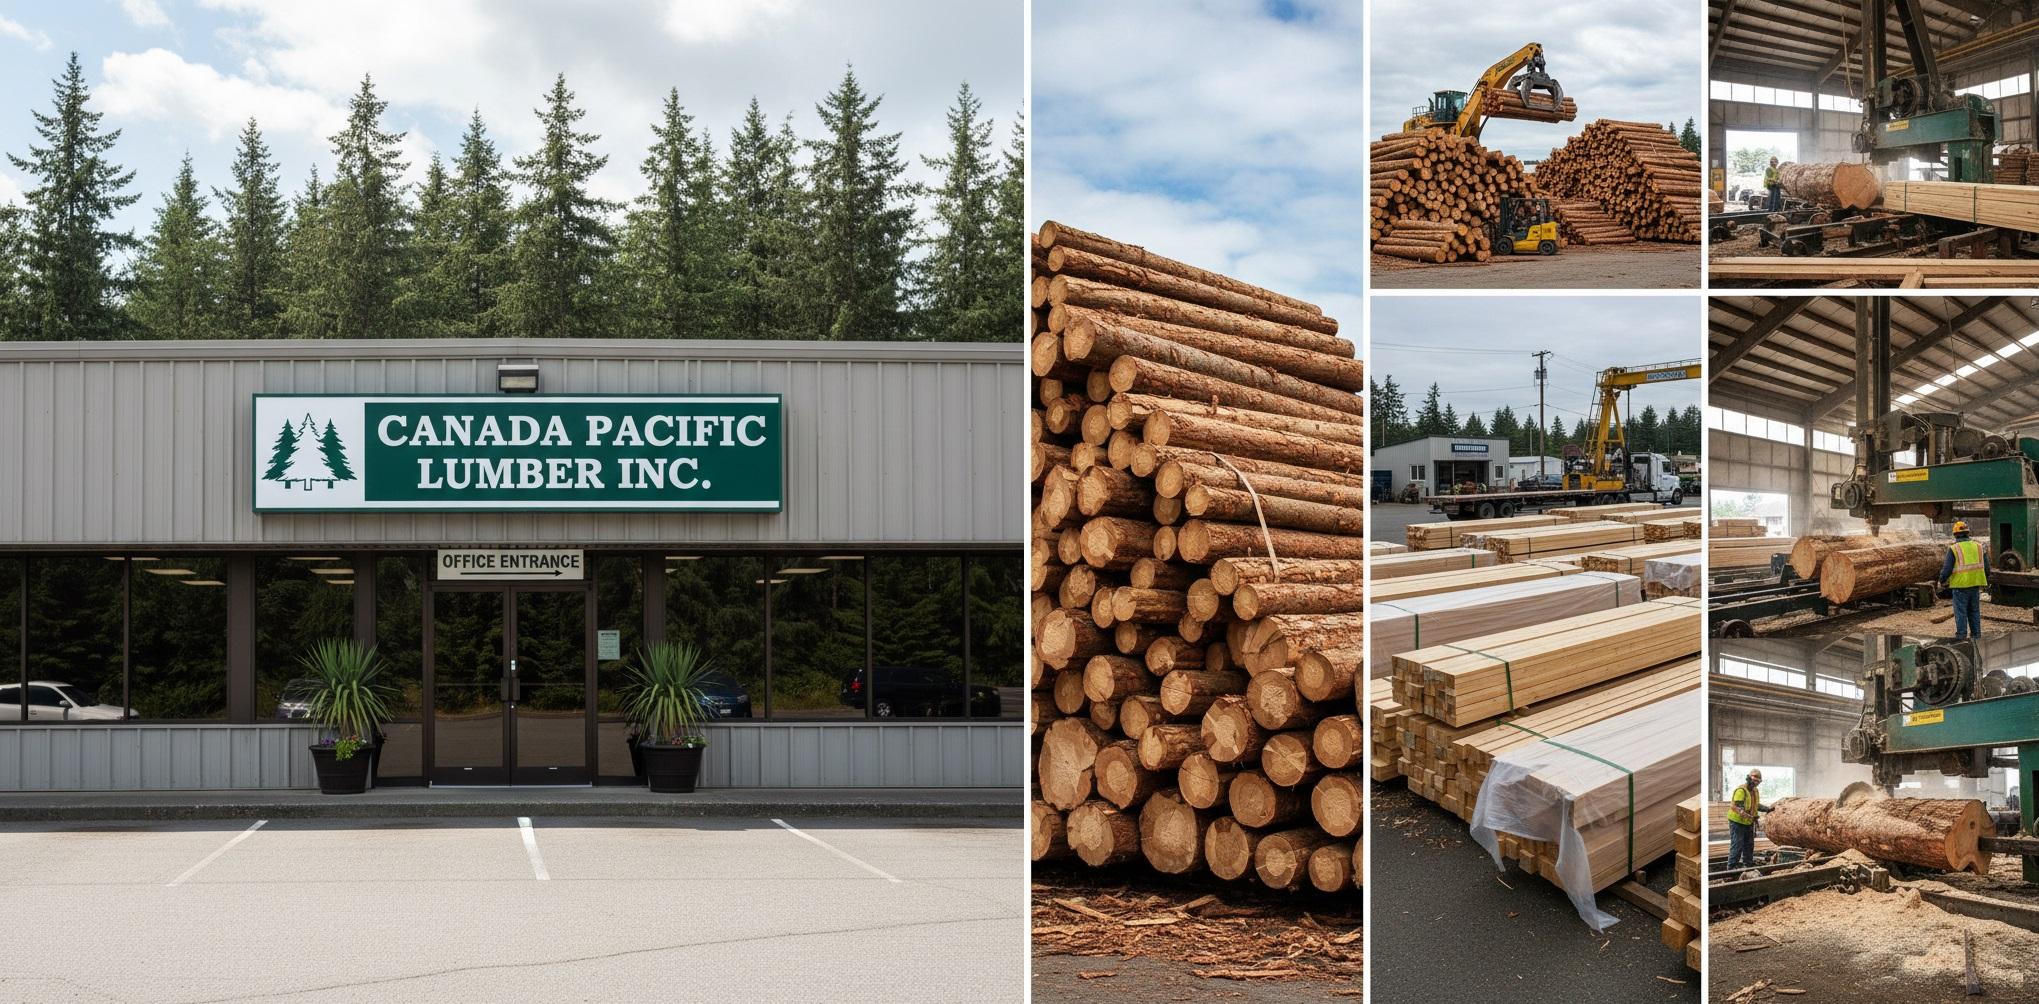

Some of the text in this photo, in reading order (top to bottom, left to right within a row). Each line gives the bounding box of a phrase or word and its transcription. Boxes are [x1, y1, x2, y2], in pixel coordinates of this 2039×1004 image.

[377, 415, 767, 447] CANADA PACIFIC
[417, 458, 711, 490] LUMBER INC.
[442, 554, 580, 569] OFFICE ENTRANCE
